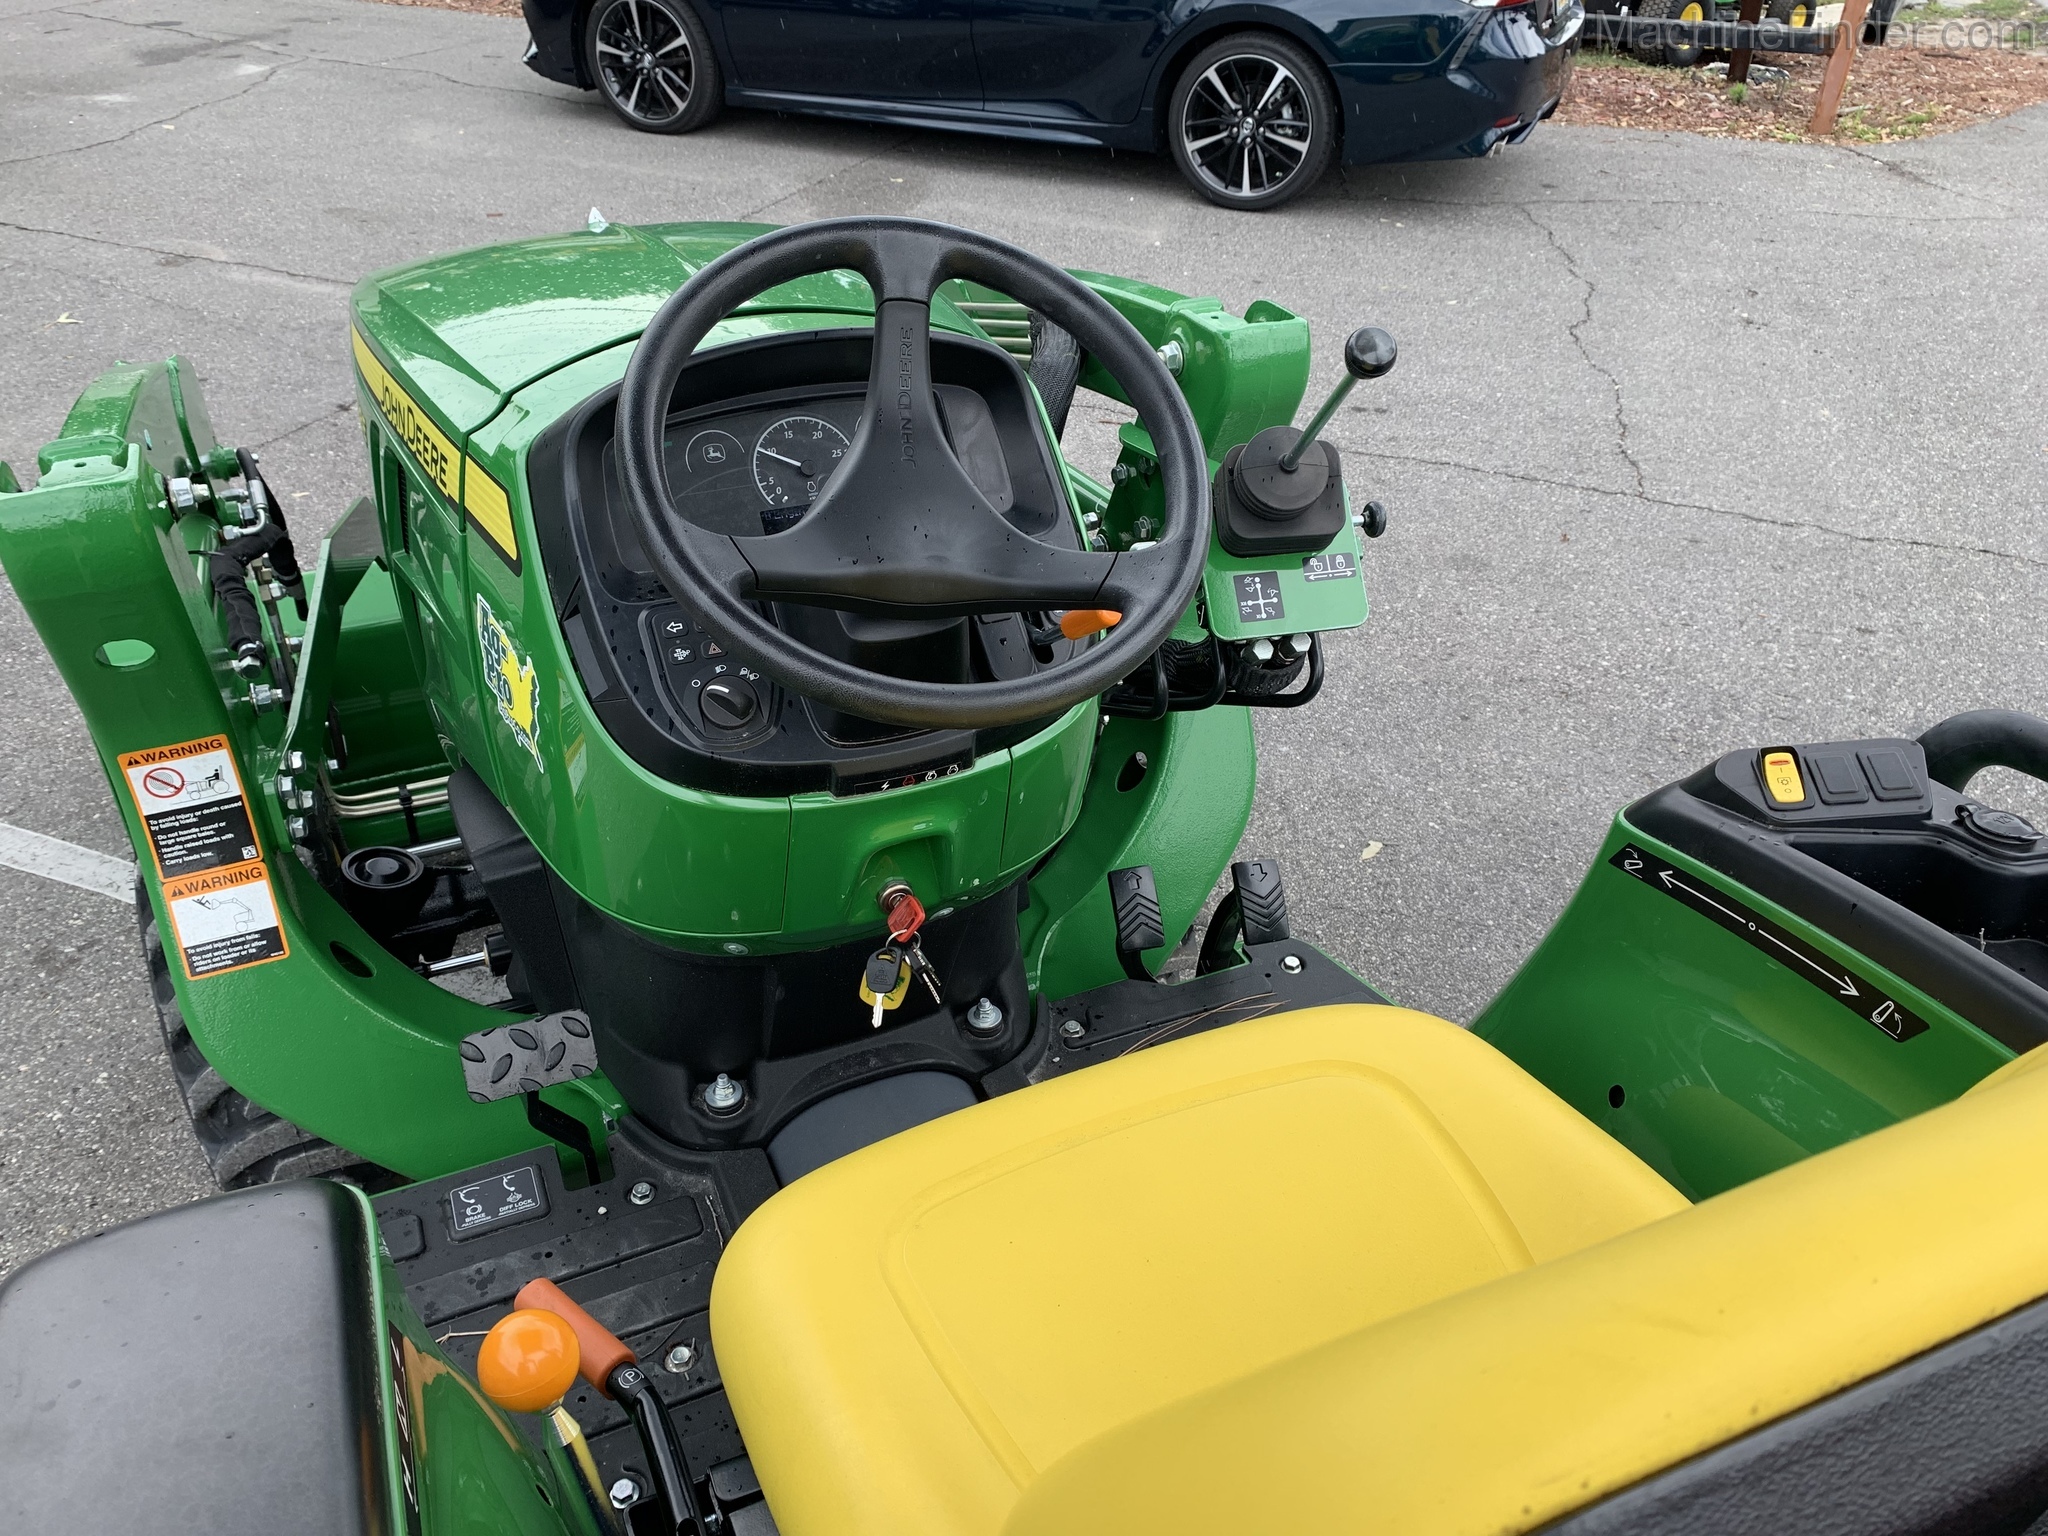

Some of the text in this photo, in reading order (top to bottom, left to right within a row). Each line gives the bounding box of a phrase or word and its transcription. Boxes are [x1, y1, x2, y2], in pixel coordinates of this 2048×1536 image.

[898, 327, 916, 469] JOHN DEERE
[381, 375, 448, 490] JOHN DEERE
[812, 431, 822, 439] 20
[832, 449, 842, 457] 25
[140, 739, 222, 762] WARNING
[159, 816, 175, 824] avoid
[176, 812, 194, 820] injury
[220, 801, 242, 810] caused
[160, 820, 179, 829] falling
[179, 827, 199, 835] handle
[159, 829, 216, 846] large square bales.
[161, 844, 183, 853] Handle
[184, 839, 203, 848] raised
[204, 836, 220, 844] loads
[163, 850, 188, 859] caution.
[165, 857, 182, 865] Carry
[183, 853, 200, 861] loads
[185, 867, 263, 893] WARNING
[196, 944, 213, 952] avoid
[213, 940, 230, 948] injury
[499, 1199, 533, 1212] DIFF LOCK
[465, 1213, 486, 1222] BRAKE
